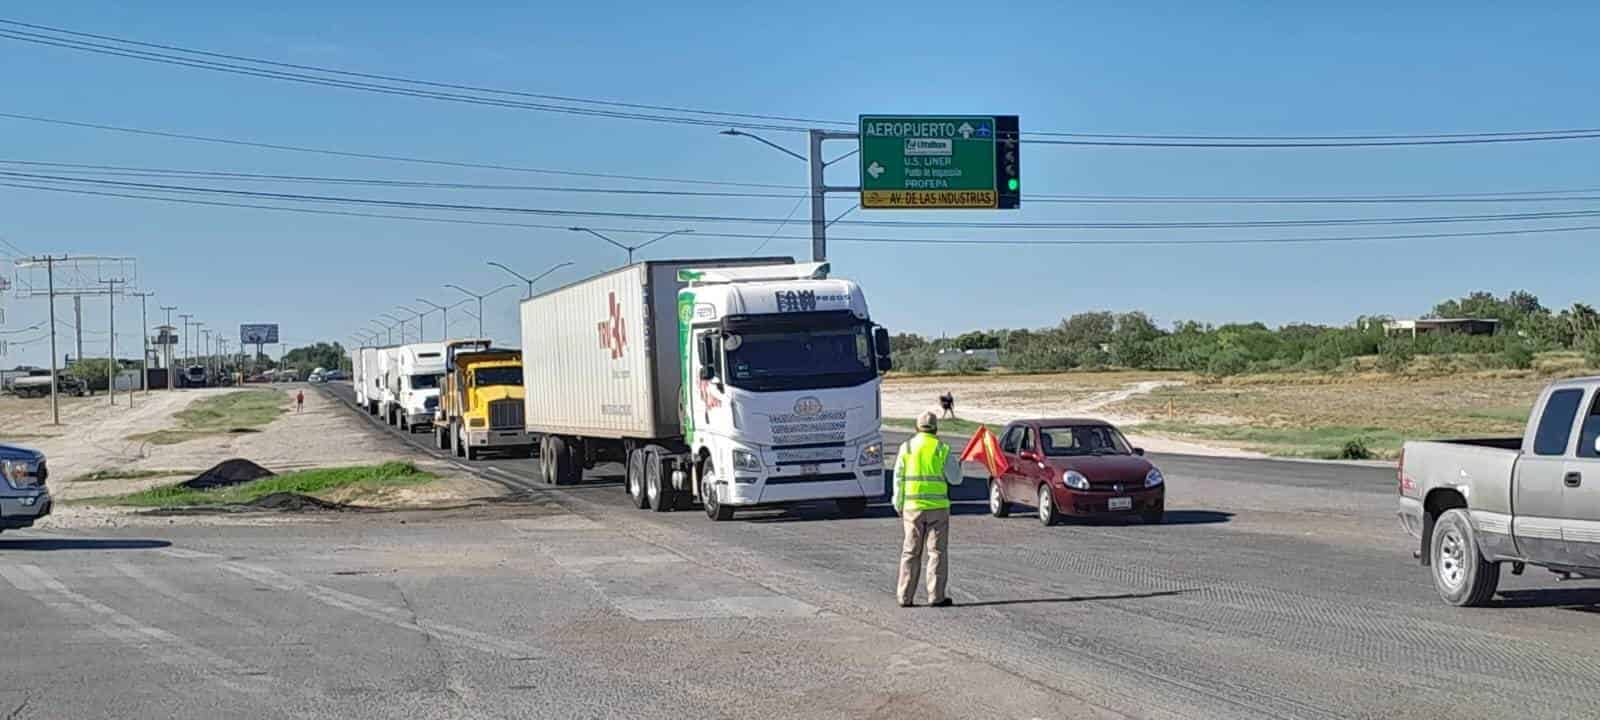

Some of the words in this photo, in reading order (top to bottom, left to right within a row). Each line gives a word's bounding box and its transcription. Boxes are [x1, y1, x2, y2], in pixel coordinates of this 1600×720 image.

[866, 122, 955, 137] AEROPUERTO
[905, 179, 948, 189] PROFEPA
[889, 192, 903, 205] AV.
[906, 192, 918, 205] DE
[919, 192, 937, 205] LAS
[939, 192, 993, 205] INDUSTRIAS
[776, 290, 816, 305] FAW
